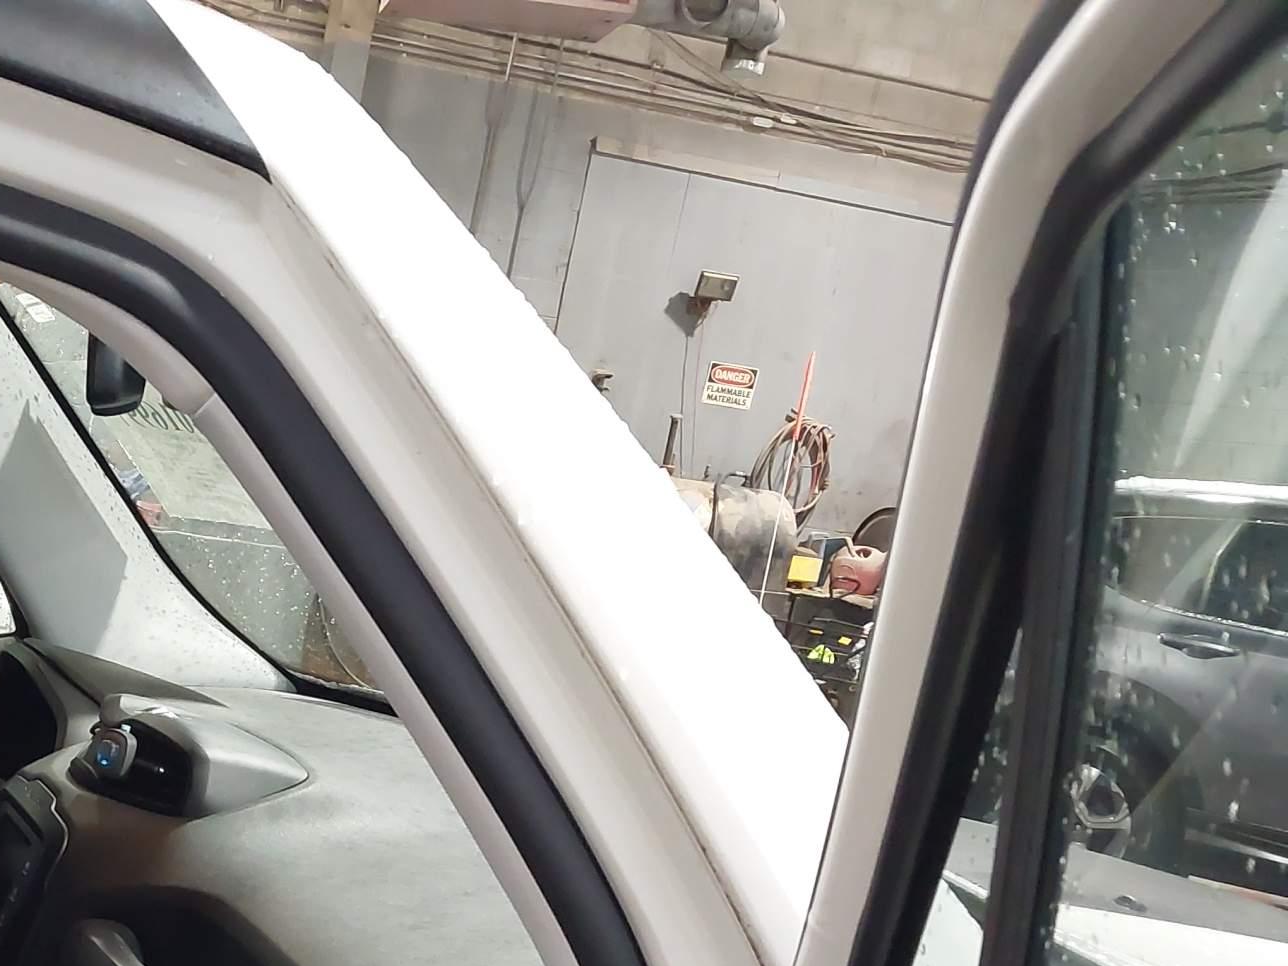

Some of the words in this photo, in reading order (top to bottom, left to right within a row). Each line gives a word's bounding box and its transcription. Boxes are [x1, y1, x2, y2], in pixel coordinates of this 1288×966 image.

[715, 369, 750, 384] DANGER
[706, 385, 751, 398] FLAMMABLE
[707, 394, 746, 406] MATERIALS
